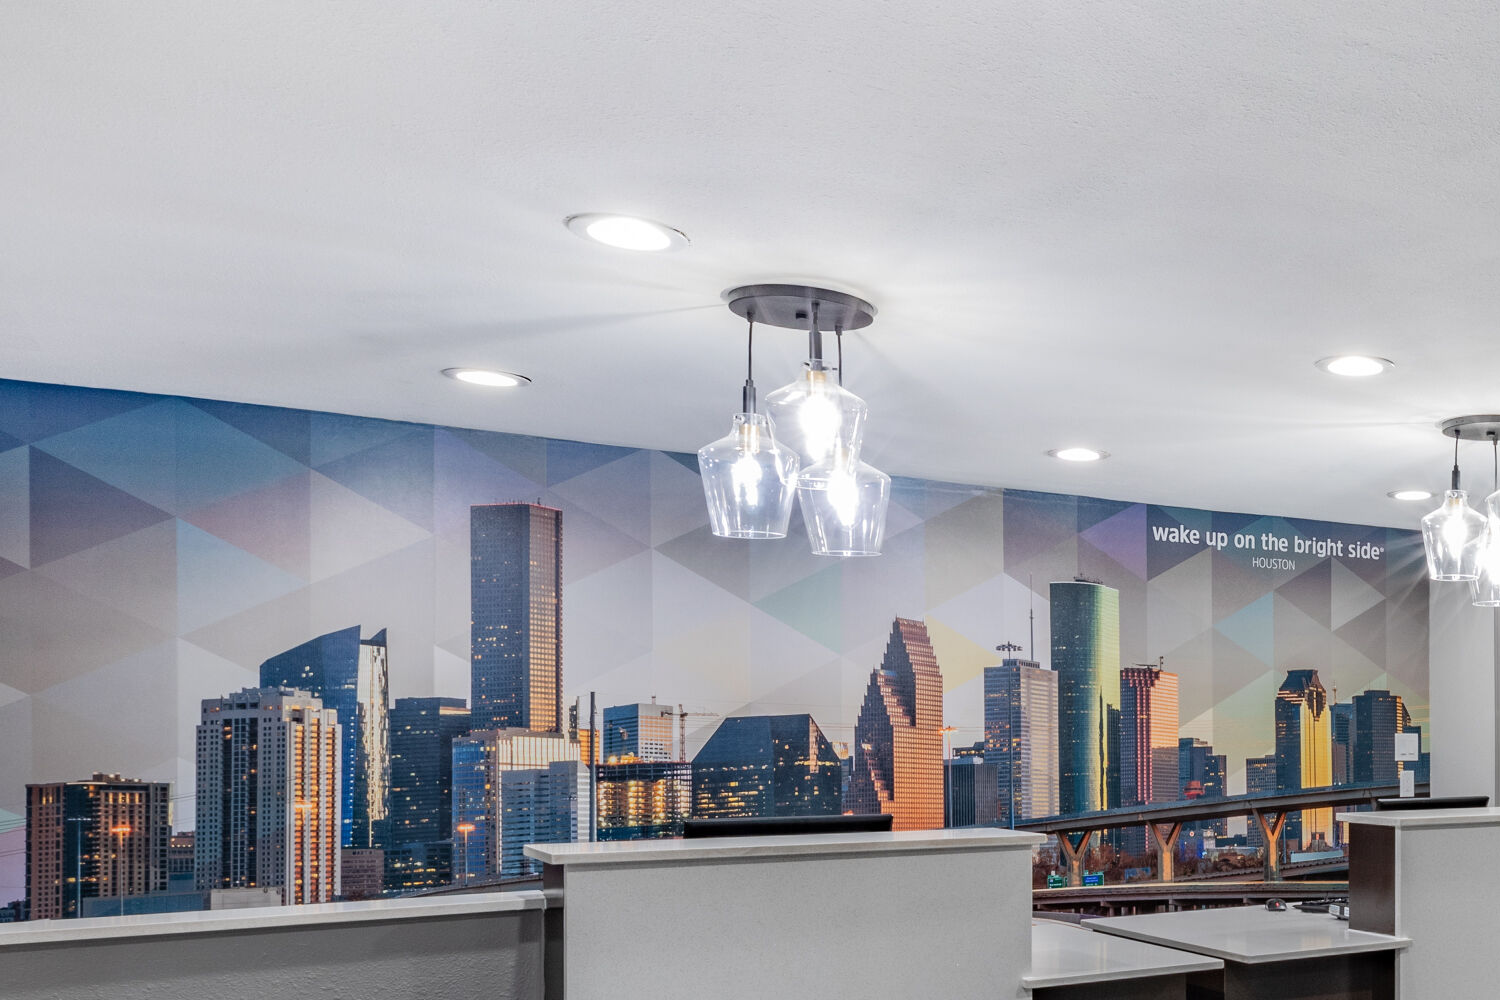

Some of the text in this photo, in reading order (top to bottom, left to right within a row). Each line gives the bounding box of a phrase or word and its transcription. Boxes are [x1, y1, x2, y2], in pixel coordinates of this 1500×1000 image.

[1152, 524, 1200, 545] wake
[1205, 531, 1228, 551] up
[1234, 533, 1256, 549] on
[1261, 533, 1288, 552] the
[1294, 535, 1344, 558] bright
[1252, 556, 1296, 571] HOUSTON
